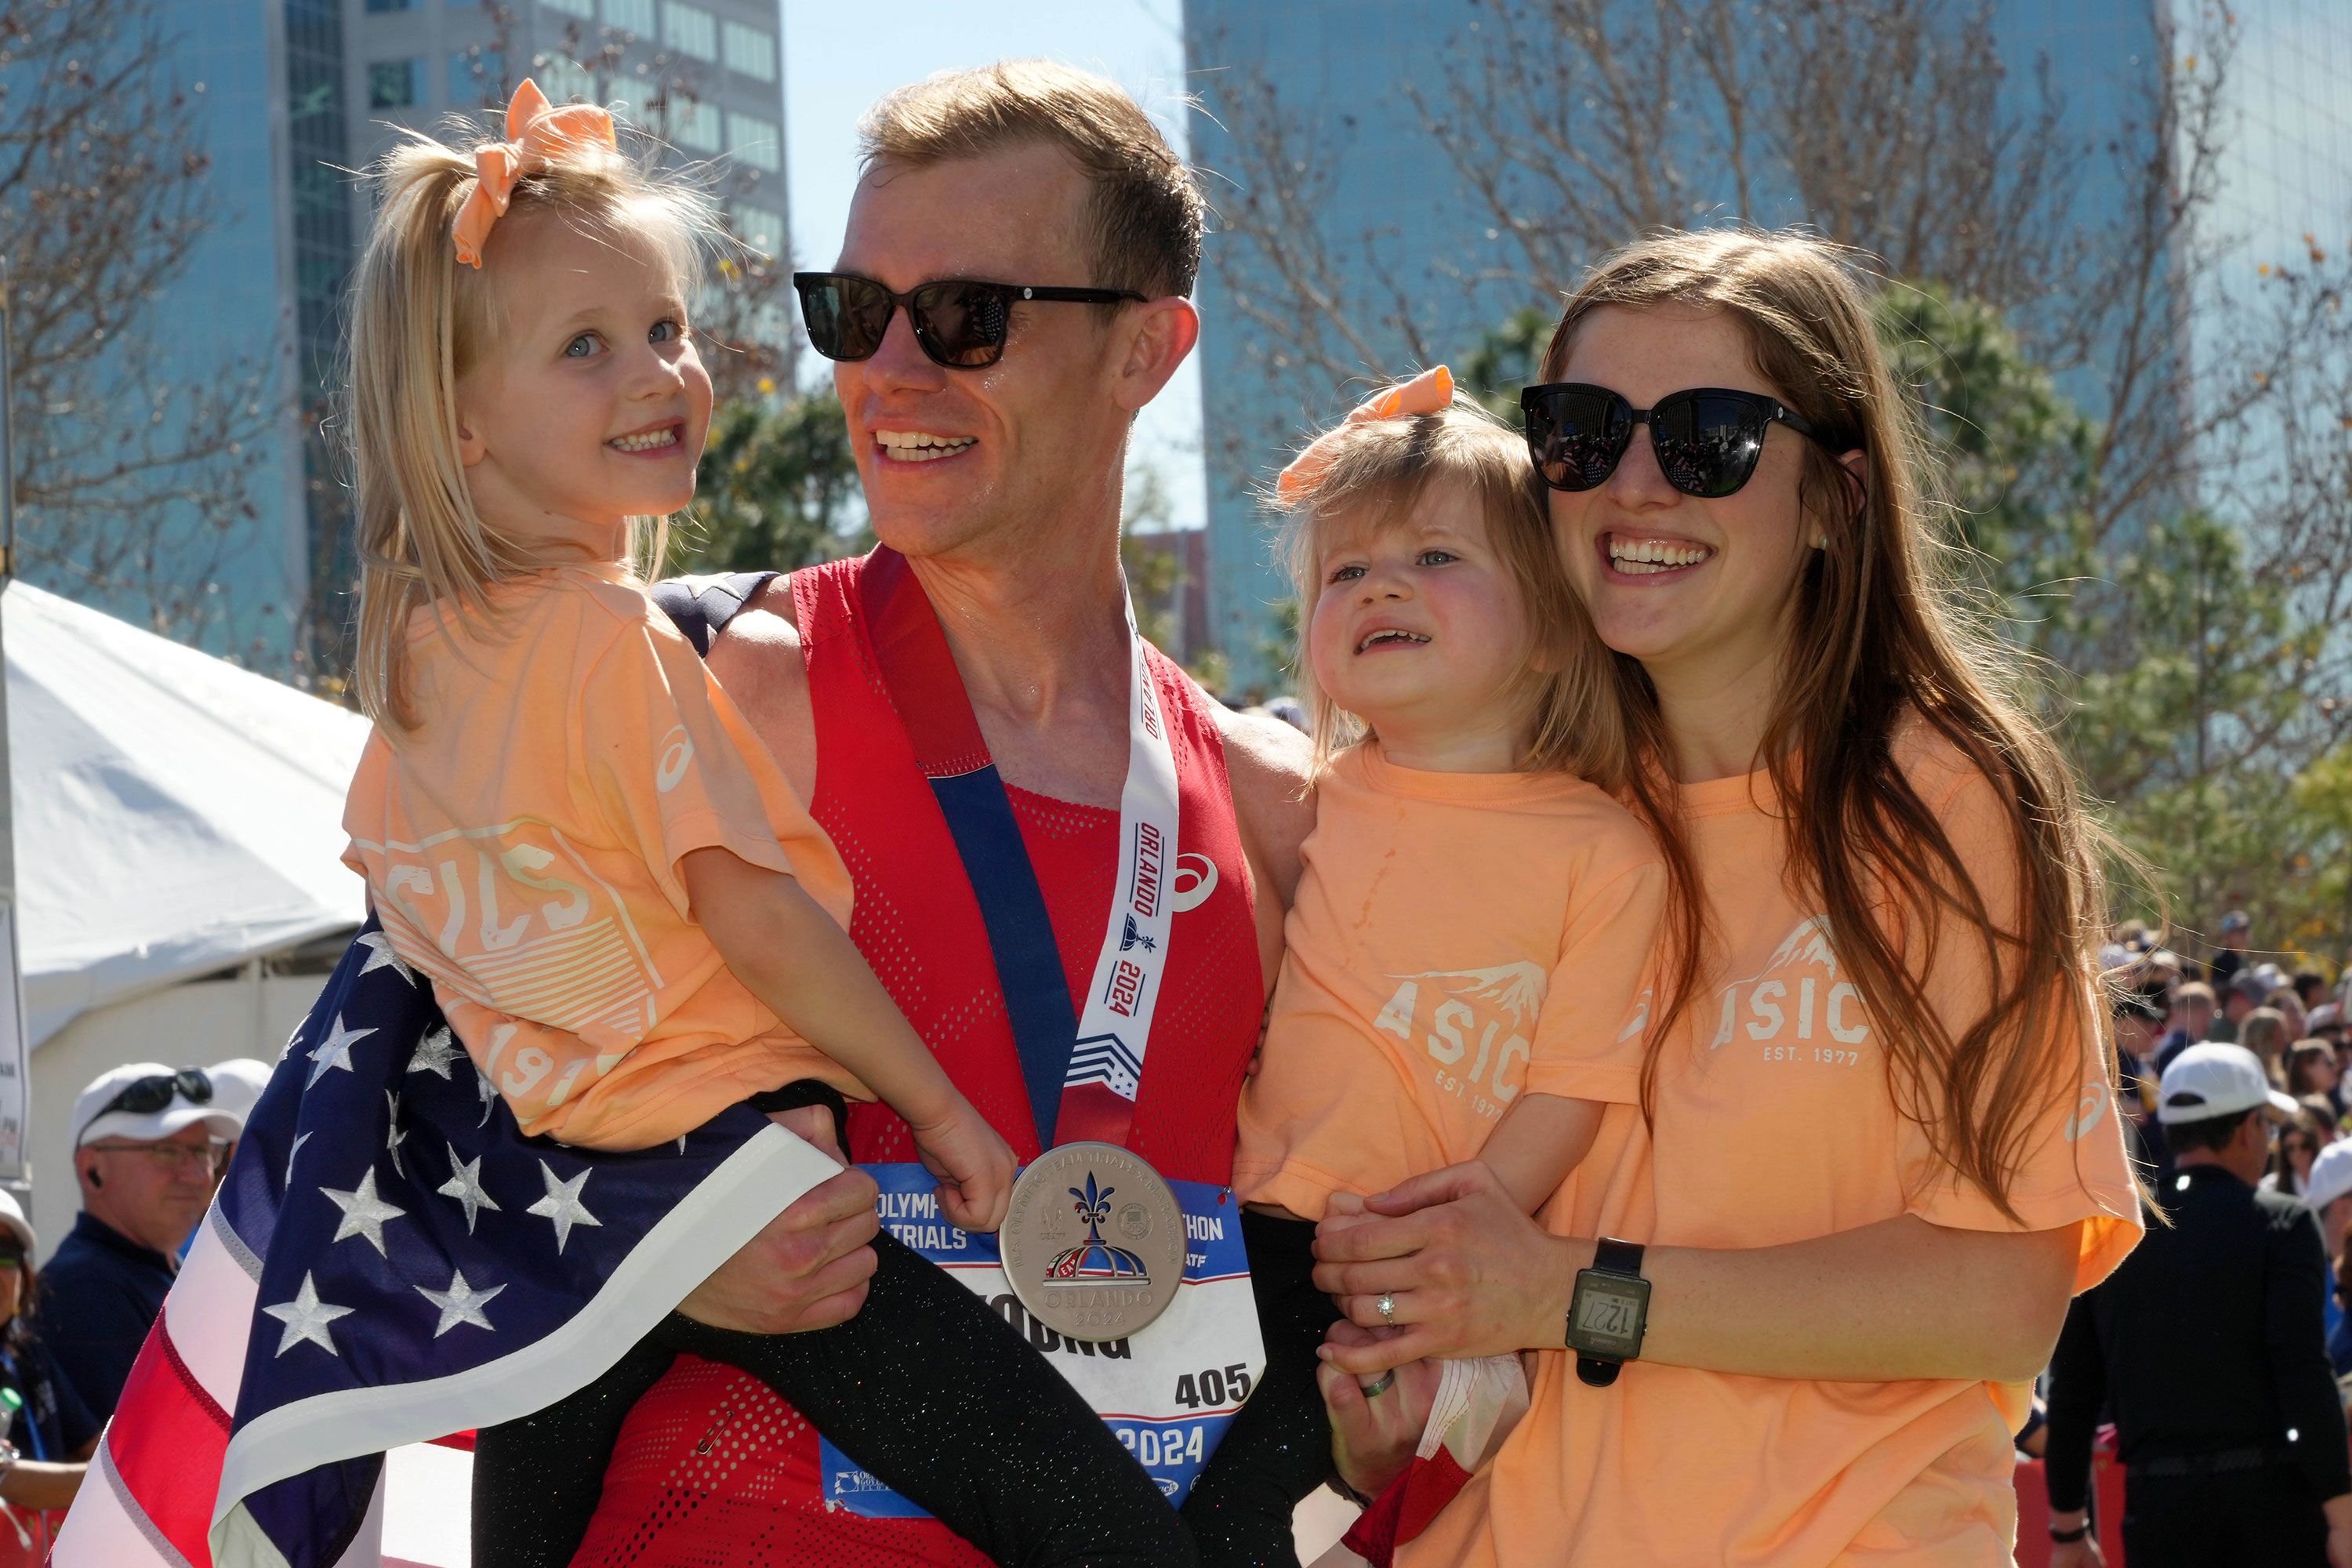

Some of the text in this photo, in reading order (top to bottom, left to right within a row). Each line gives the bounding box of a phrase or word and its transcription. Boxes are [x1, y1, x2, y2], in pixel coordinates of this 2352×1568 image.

[1134, 822, 1160, 917] ORLANDO
[1109, 960, 1141, 1017] 2024
[1764, 1046, 1859, 1066] EST. 1977
[890, 1224, 967, 1250] TRIALS
[1182, 1214, 1224, 1241] HON
[1044, 1290, 1152, 1308] ORLANDO
[1074, 1310, 1127, 1327] 2024
[1175, 1363, 1251, 1409] 405
[1115, 1425, 1203, 1466] 2024
